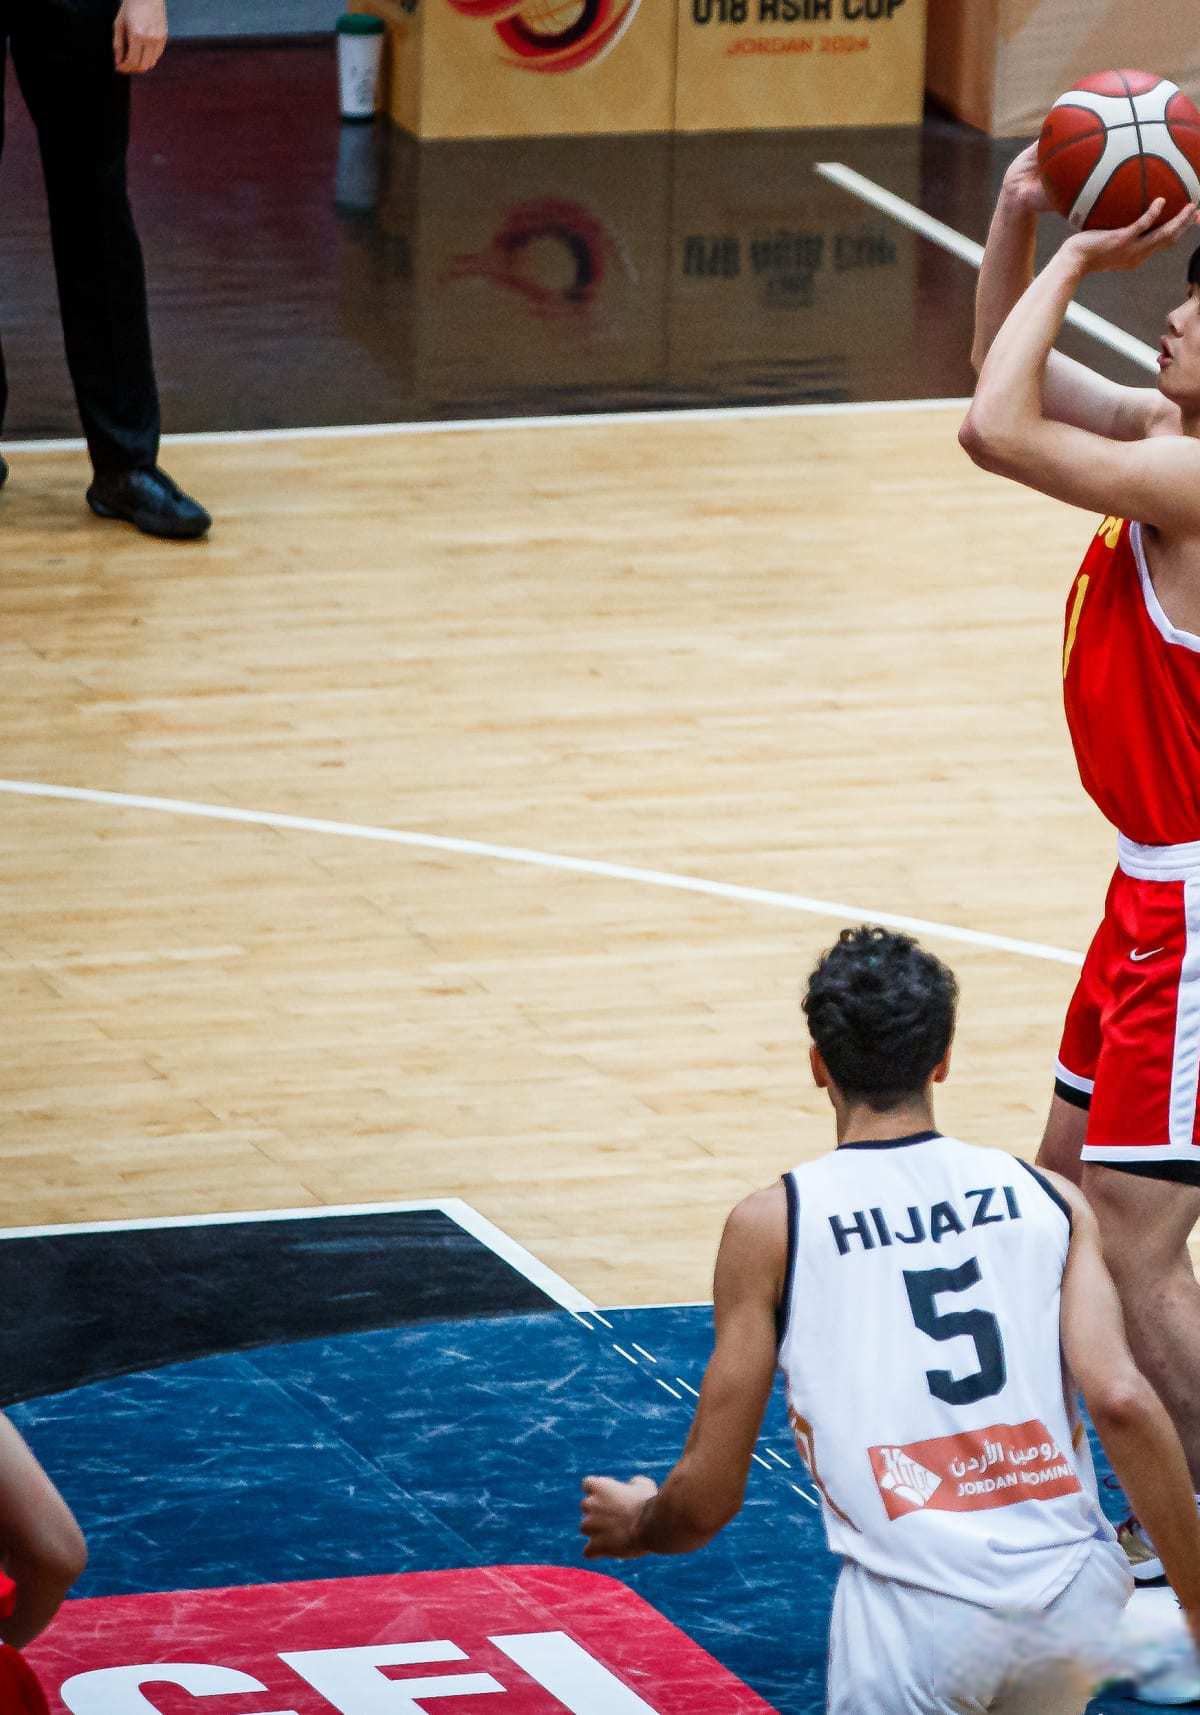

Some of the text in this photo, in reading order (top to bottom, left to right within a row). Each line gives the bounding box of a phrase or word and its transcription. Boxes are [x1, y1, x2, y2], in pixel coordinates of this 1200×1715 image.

[726, 37, 813, 56] JORDAN
[828, 1186, 1022, 1256] HIJAZI
[902, 1256, 1008, 1406] 5
[957, 1472, 1018, 1497] JORDAN
